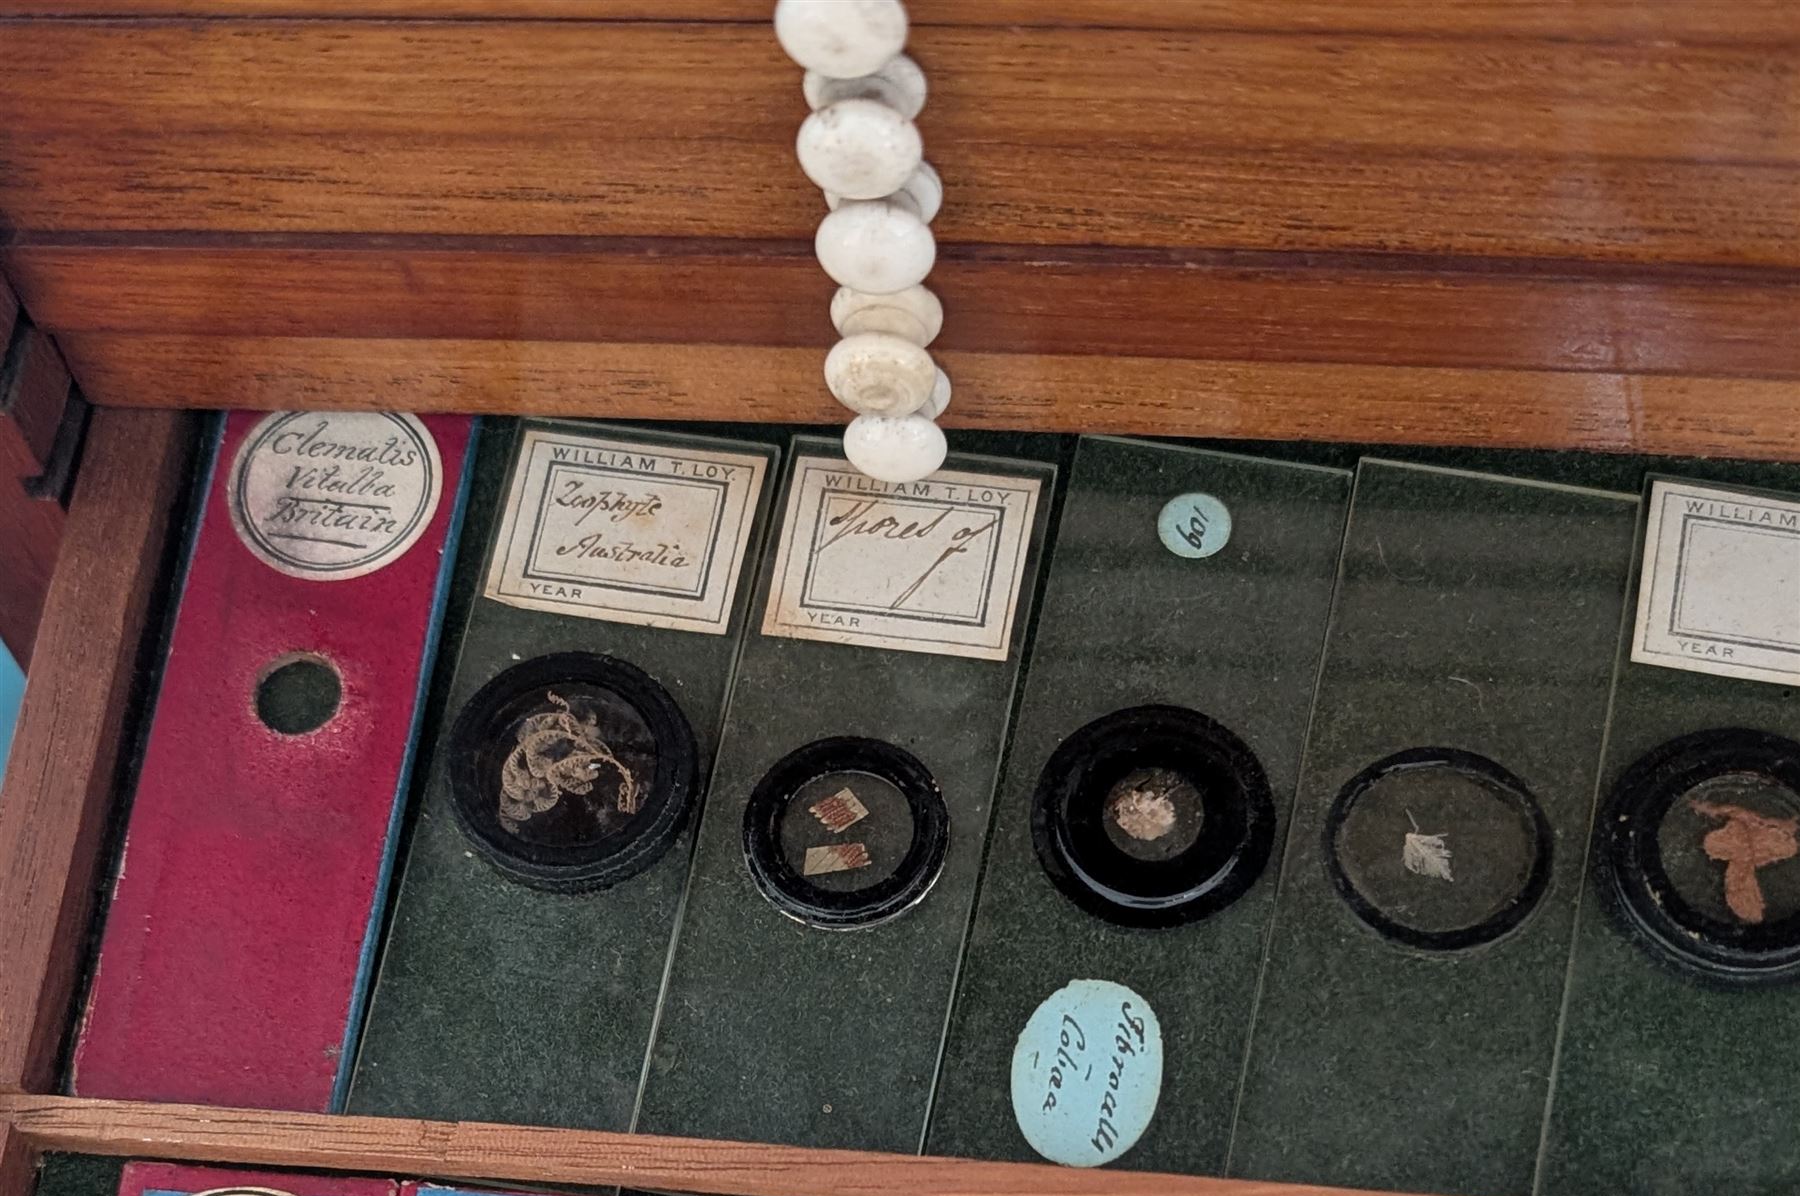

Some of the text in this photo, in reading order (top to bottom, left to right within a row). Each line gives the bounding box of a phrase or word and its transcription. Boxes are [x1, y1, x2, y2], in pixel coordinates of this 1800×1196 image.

[272, 421, 416, 466] Clematis
[553, 447, 656, 471] WILLIAM
[825, 474, 930, 497] WILLIAM
[264, 497, 396, 534] Britain
[1686, 500, 1797, 527] WILLIAM
[556, 534, 689, 567] Australia
[530, 583, 582, 599] YEAR
[808, 612, 860, 627] YEAR
[1677, 640, 1734, 658] YEAR
